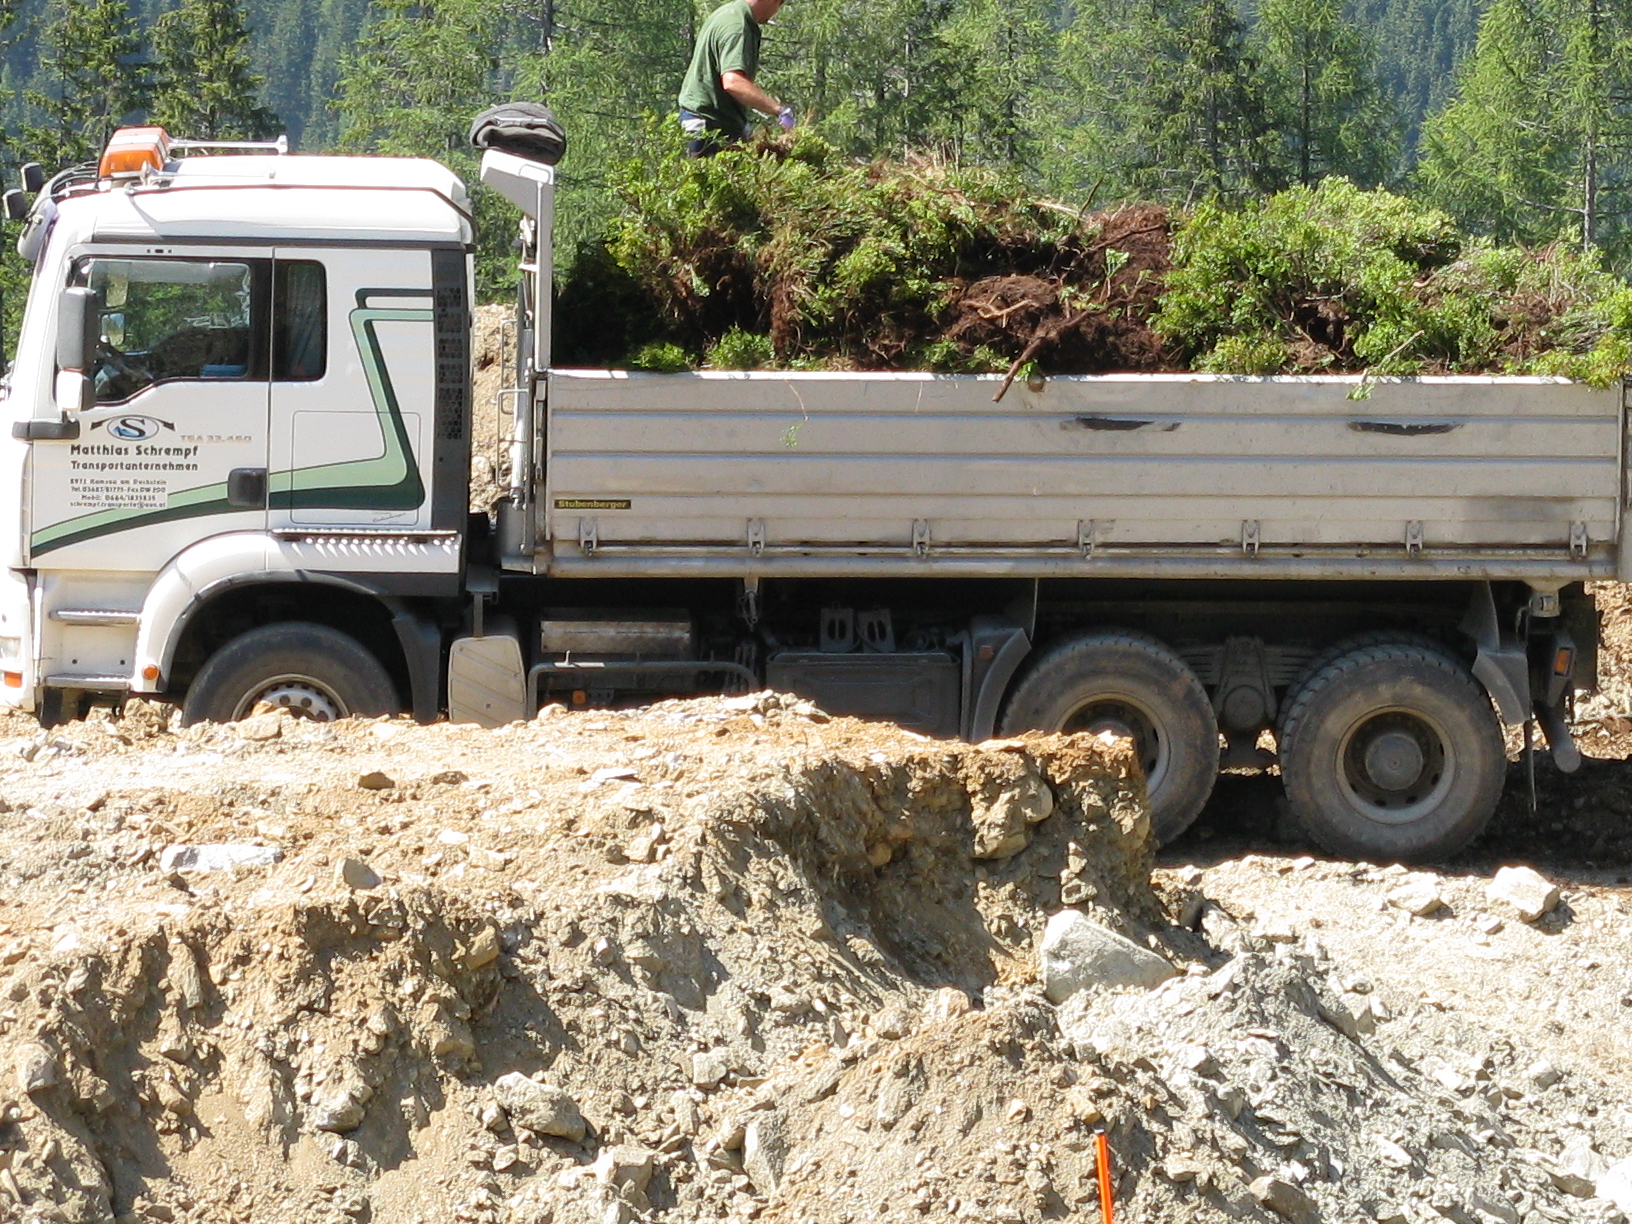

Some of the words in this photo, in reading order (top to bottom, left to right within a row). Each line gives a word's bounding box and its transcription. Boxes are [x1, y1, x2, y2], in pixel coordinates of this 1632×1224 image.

[70, 444, 129, 456] Matthias
[136, 444, 199, 459] Schrempf
[71, 460, 199, 472] Transportunternehmen
